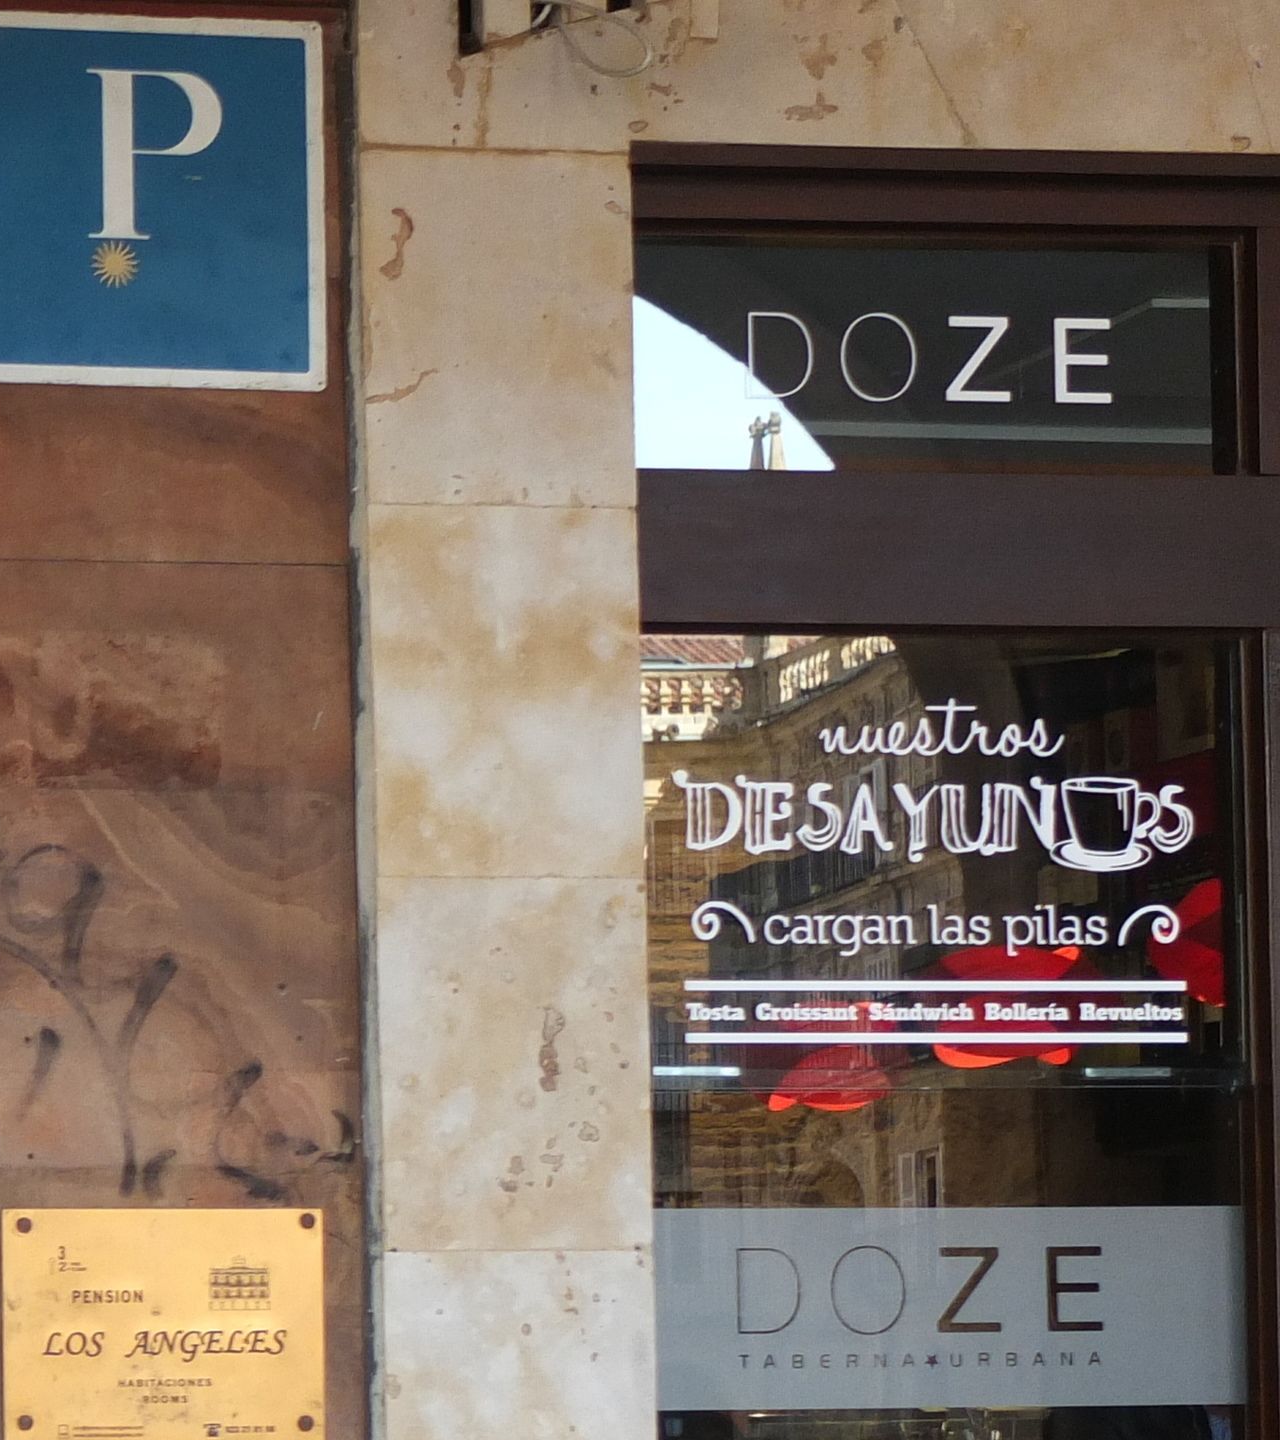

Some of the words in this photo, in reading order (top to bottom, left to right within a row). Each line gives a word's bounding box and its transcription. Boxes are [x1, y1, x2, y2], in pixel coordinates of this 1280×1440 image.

[85, 67, 223, 240] P
[744, 311, 1114, 405] DOZE
[818, 697, 1065, 758] nuestros
[762, 910, 915, 956] cargan
[927, 904, 992, 947] las
[1002, 904, 1109, 956] pilas
[685, 1003, 746, 1023] Tosta
[754, 1002, 859, 1023] Croissant
[868, 1000, 974, 1023] Sándwich
[983, 1002, 1070, 1022] Bollería
[1079, 1002, 1184, 1022] Revueltos
[71, 1289, 145, 1304] PENSION
[735, 1245, 1105, 1336] DOZE
[42, 1331, 106, 1358] LOS
[124, 1328, 288, 1363] ANGELES
[738, 1353, 916, 1369] TABERNA
[949, 1350, 1103, 1368] URBANA
